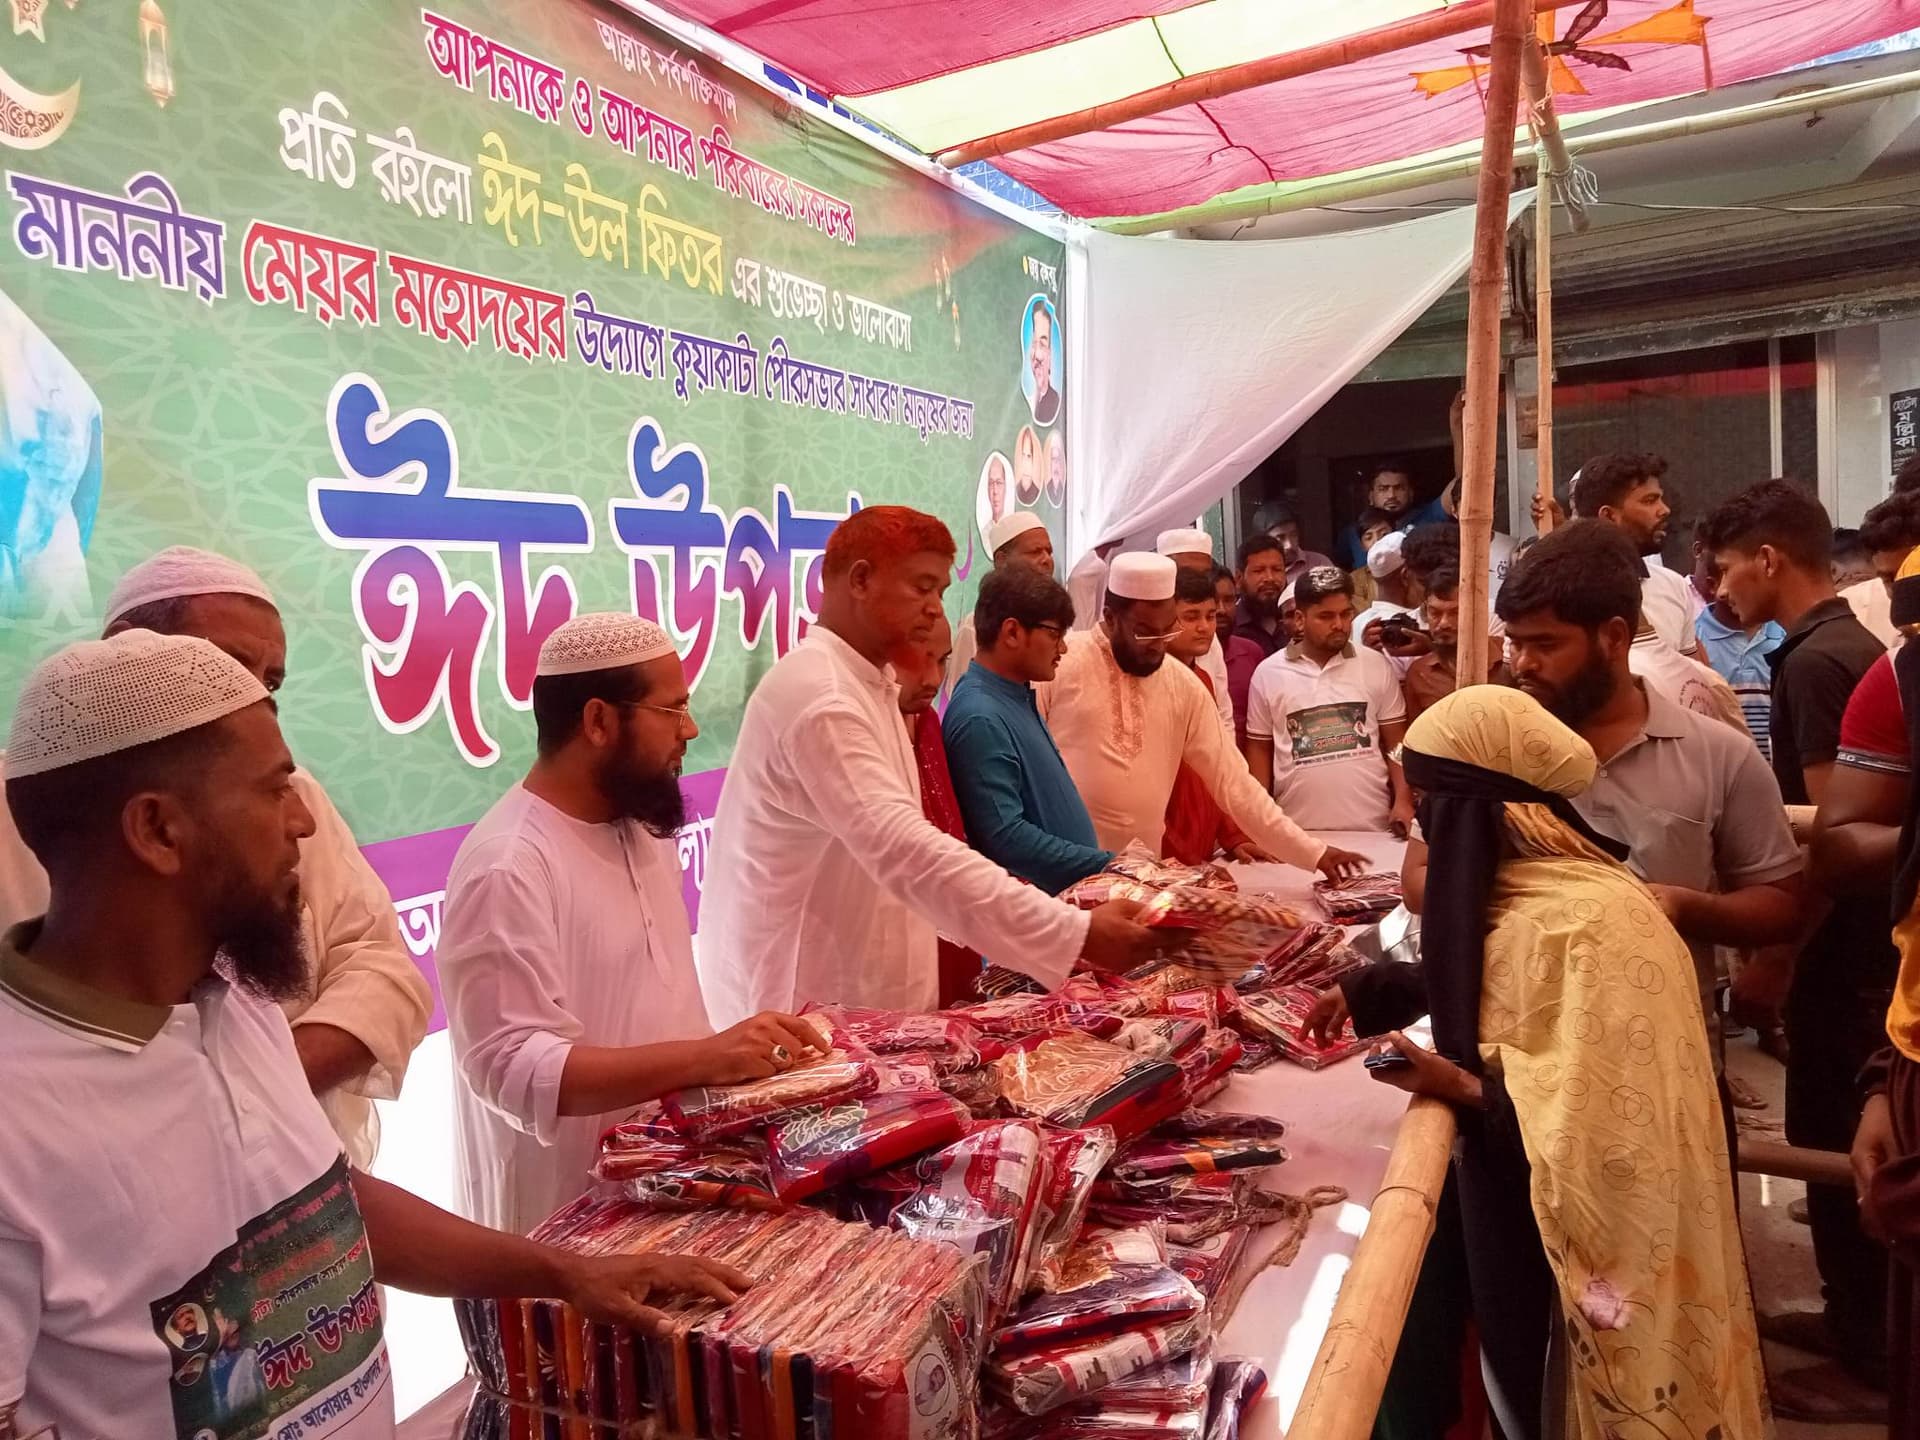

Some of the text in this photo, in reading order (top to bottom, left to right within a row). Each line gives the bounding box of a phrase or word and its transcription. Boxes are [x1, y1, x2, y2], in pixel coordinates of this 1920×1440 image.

[423, 8, 566, 126] আপনাকে
[569, 77, 595, 138] ও
[597, 84, 699, 180] আপনার
[699, 123, 796, 221] পরিবারের
[790, 175, 856, 246] সকলের
[594, 17, 657, 87] আল্লাহ
[5, 168, 974, 446] মাননীয় মেয়র মহোদয়ের উদ্যোগে কুয়াকাটা পৌরসভার সাধারণ মানুষের জন্য
[278, 90, 912, 352] প্রতি রইলো ঈদ-উল ফিতর এর শুভেচ্ছা ও ভালোবাসা
[308, 372, 593, 767] ঈদ
[255, 1337, 314, 1391] ঈদ
[300, 1387, 353, 1428] আনোয়ার
